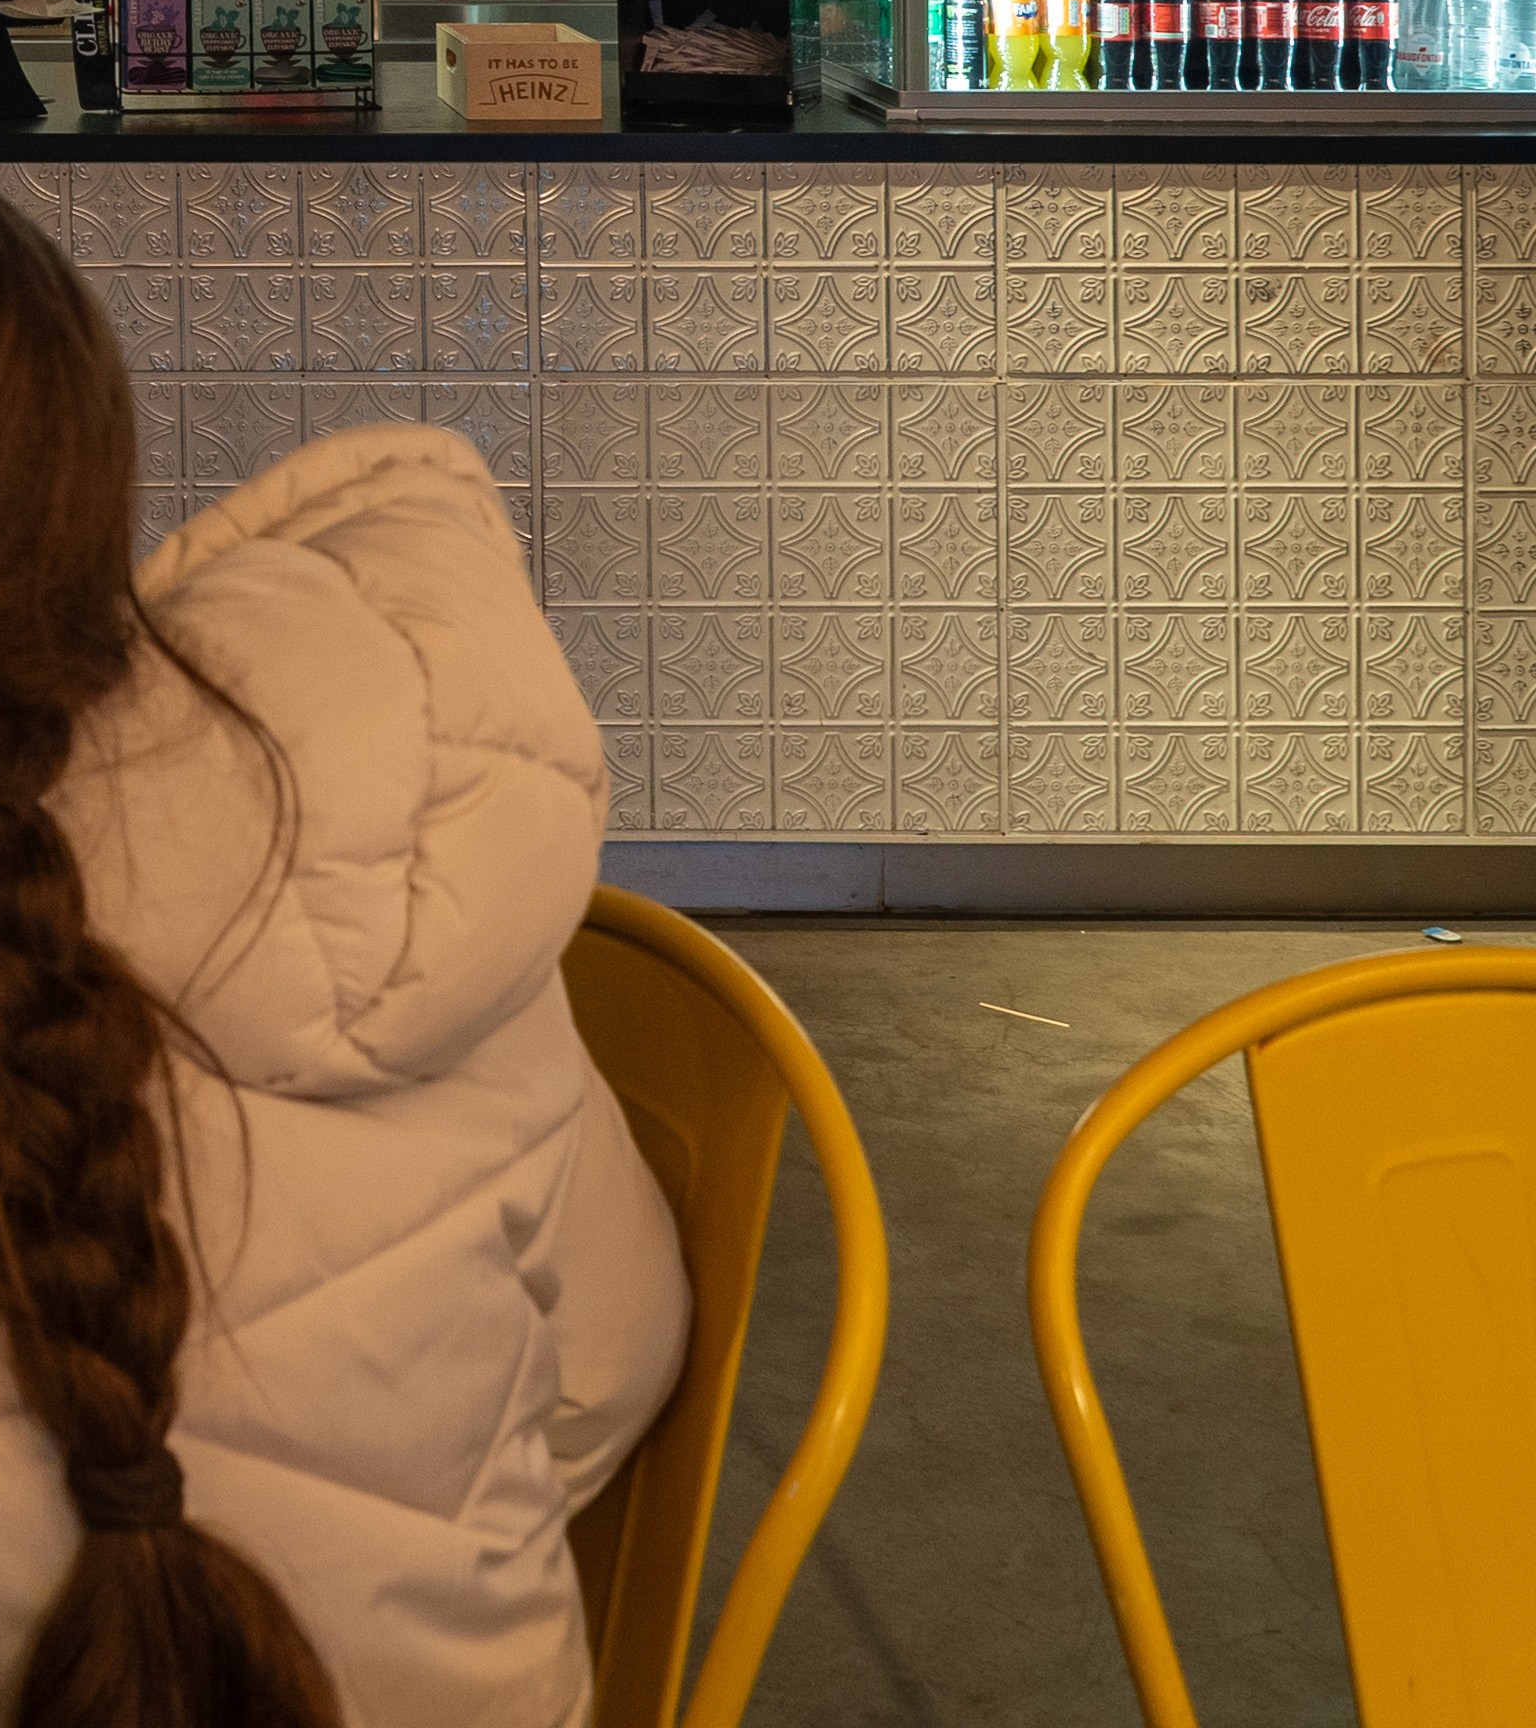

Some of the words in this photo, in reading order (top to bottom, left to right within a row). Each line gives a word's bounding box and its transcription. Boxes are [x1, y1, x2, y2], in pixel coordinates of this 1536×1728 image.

[488, 59, 502, 69] IT
[506, 59, 535, 69] HAS
[538, 59, 558, 69] TO
[563, 59, 579, 69] BE
[499, 81, 568, 103] HEINZ
